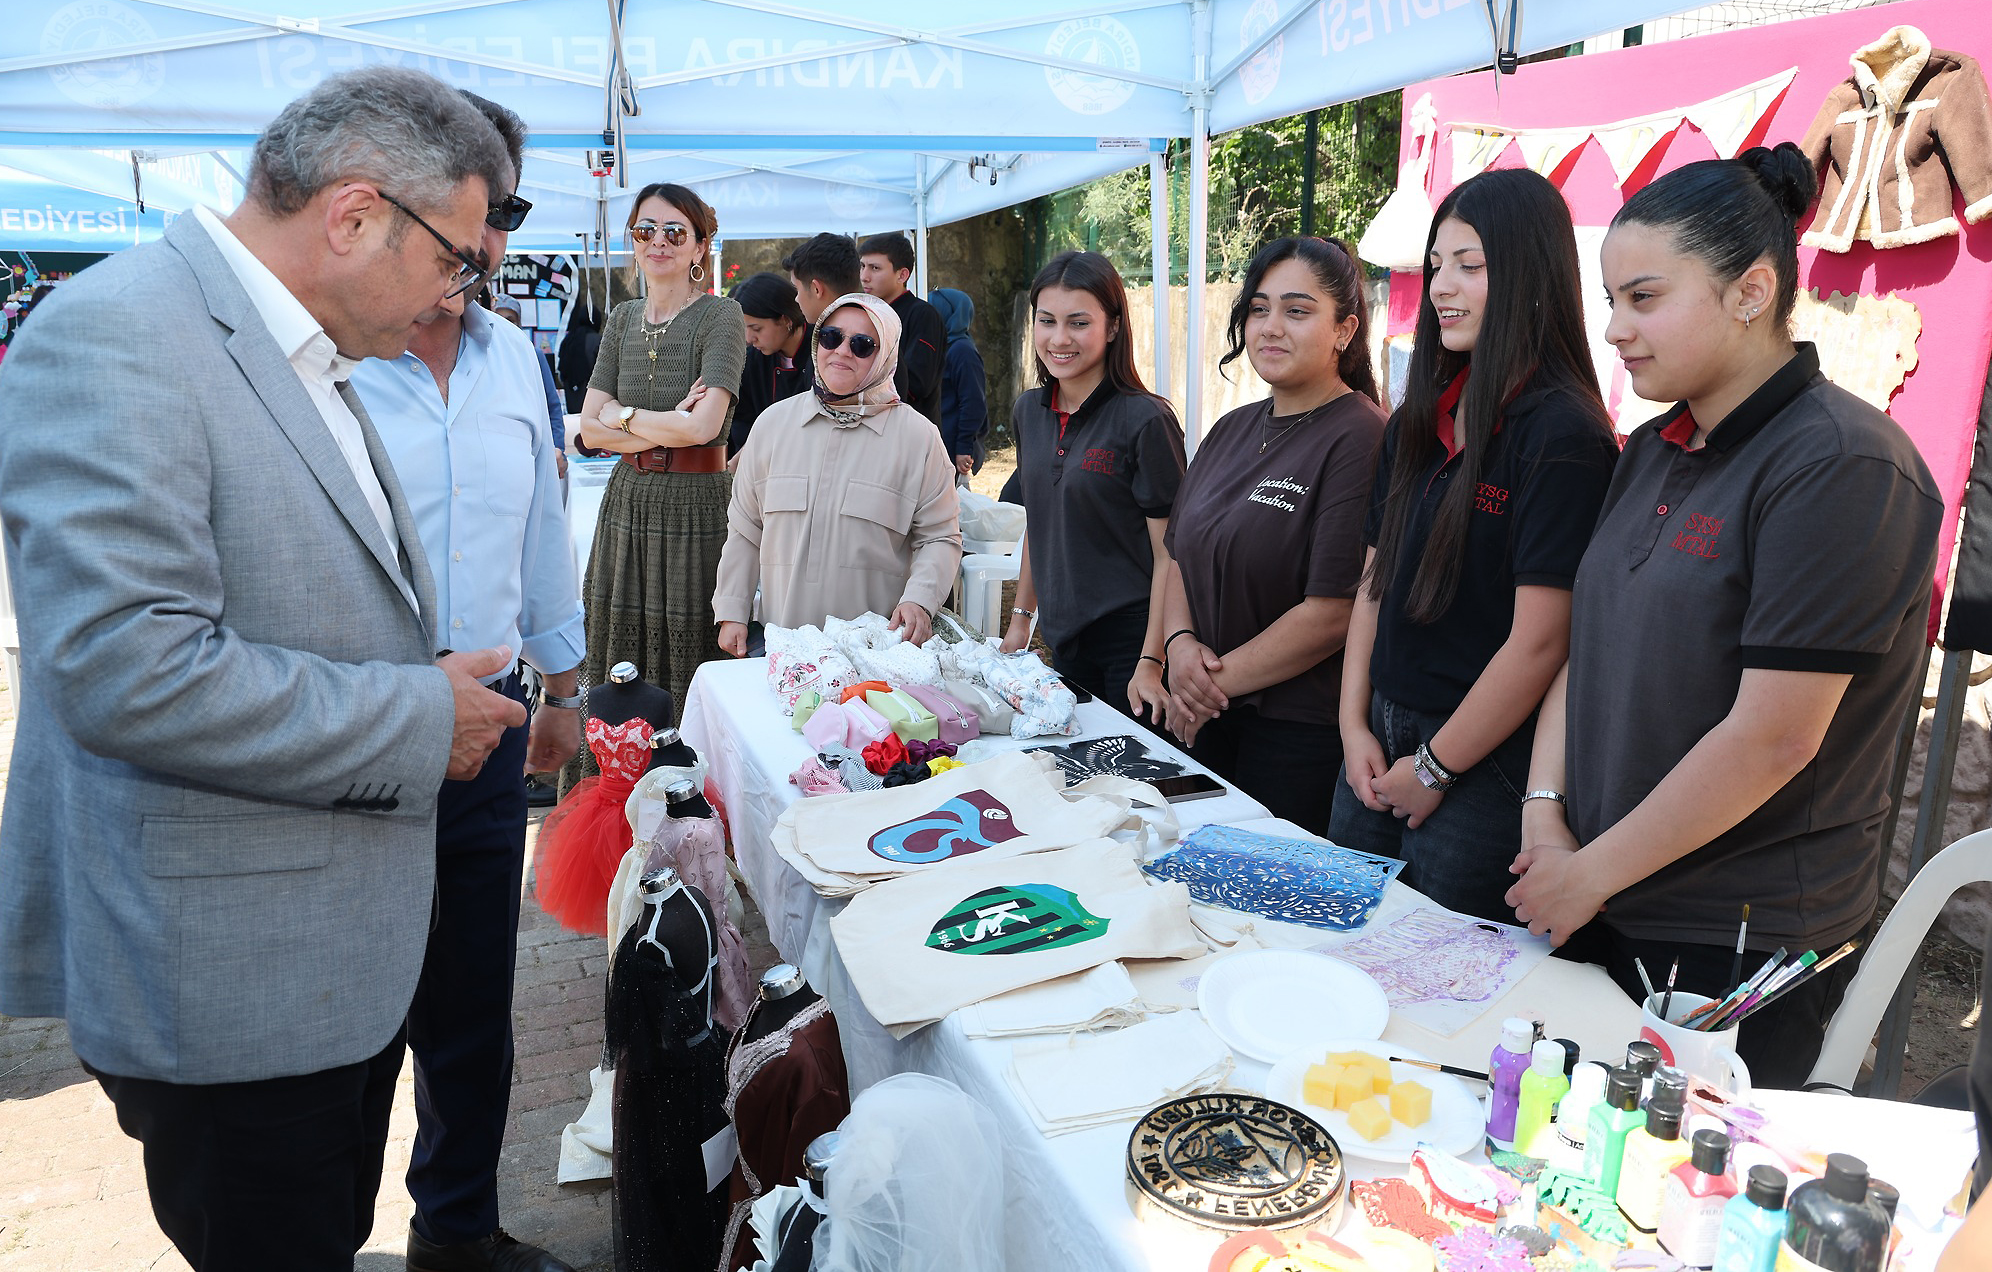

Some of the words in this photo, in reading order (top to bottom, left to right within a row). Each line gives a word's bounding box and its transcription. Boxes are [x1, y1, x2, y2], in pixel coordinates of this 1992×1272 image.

[1256, 475, 1310, 495] Location:
[1475, 482, 1509, 501] YSG
[1247, 487, 1296, 512] Vacation
[1473, 496, 1504, 515] TAL
[936, 930, 956, 948] 1966
